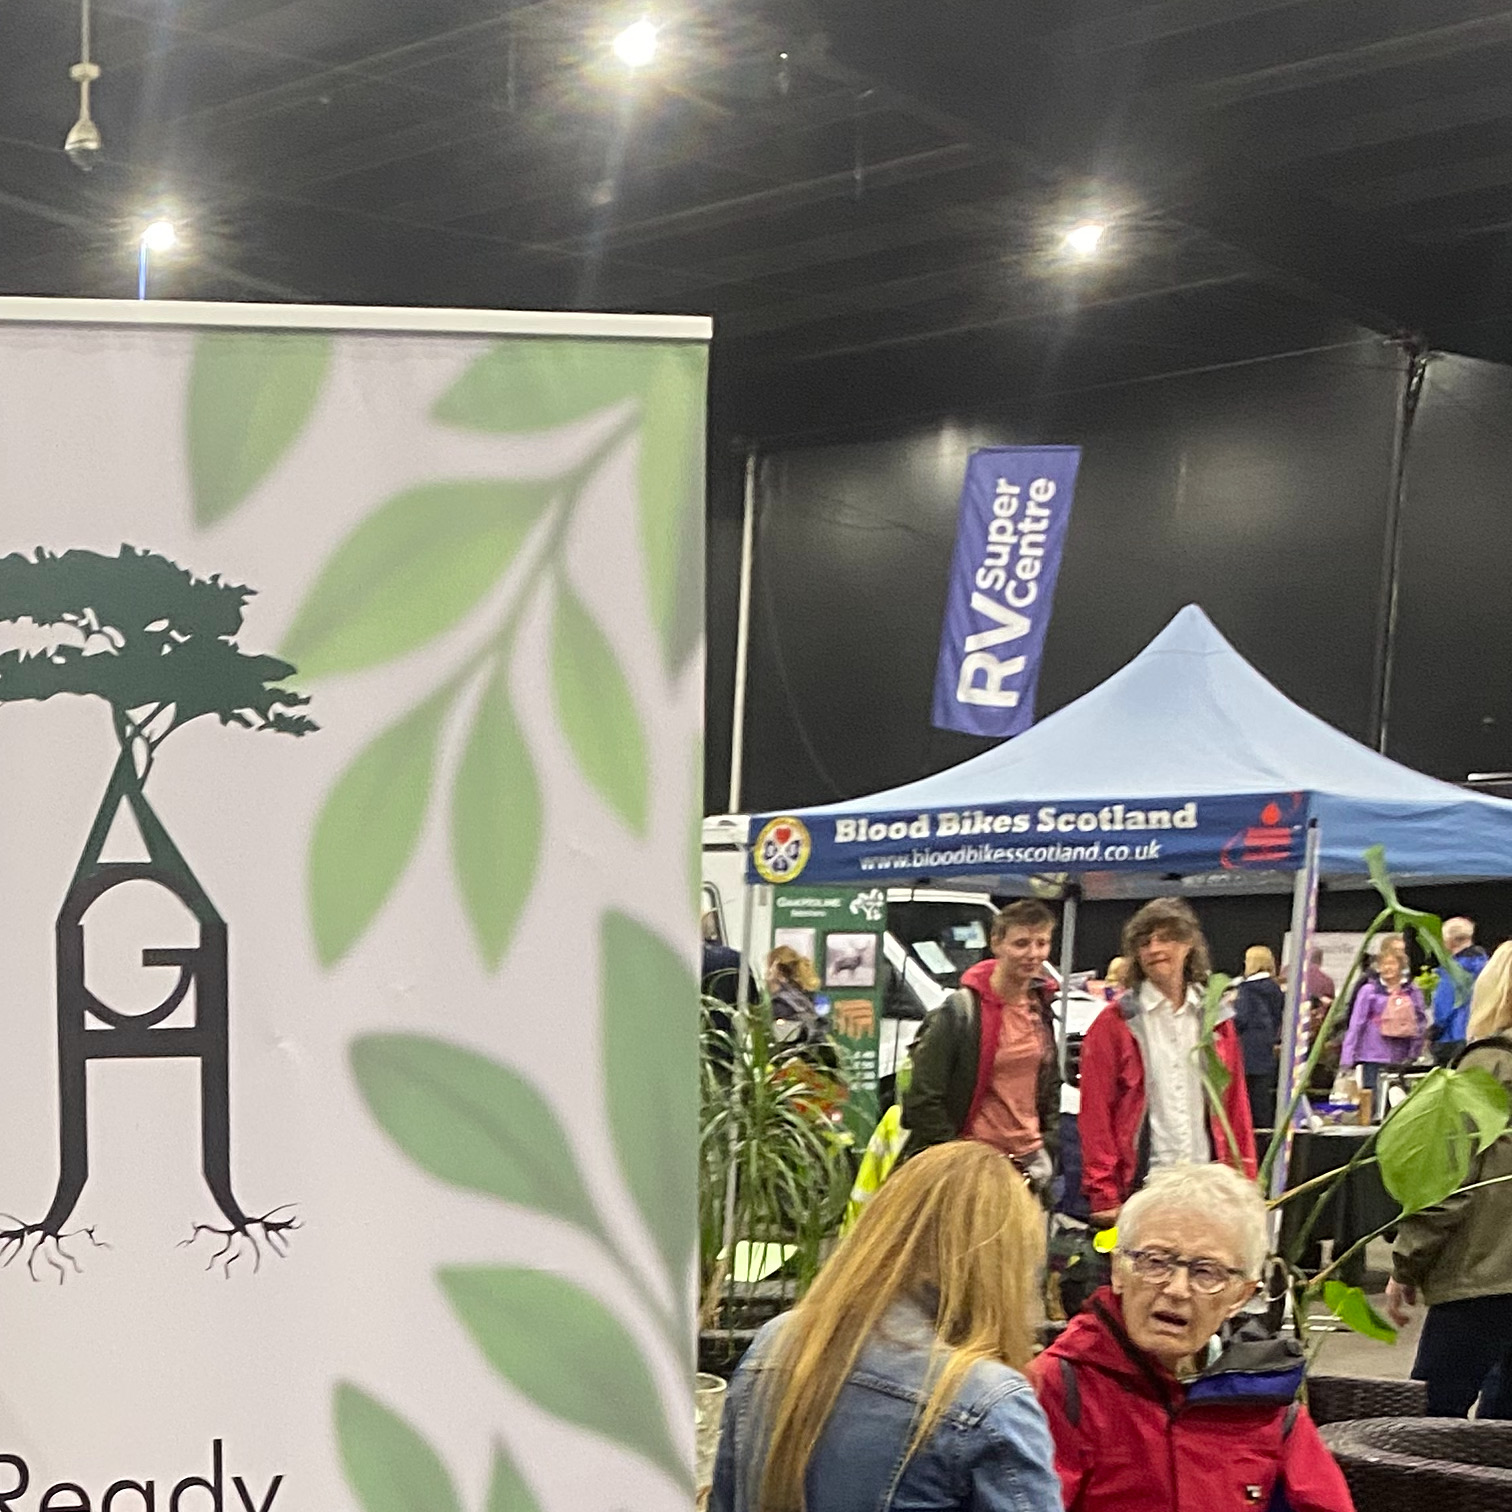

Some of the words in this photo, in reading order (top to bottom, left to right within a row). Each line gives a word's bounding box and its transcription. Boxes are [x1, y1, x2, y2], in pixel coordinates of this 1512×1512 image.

[975, 477, 1021, 591] Super
[1005, 477, 1057, 608] Centre
[956, 591, 1032, 708] RV
[835, 814, 931, 843] Blood
[936, 810, 1030, 837] Bikes
[1037, 802, 1198, 832] Scotland
[859, 839, 1162, 870] www.bloodbikesscotland.co.uk
